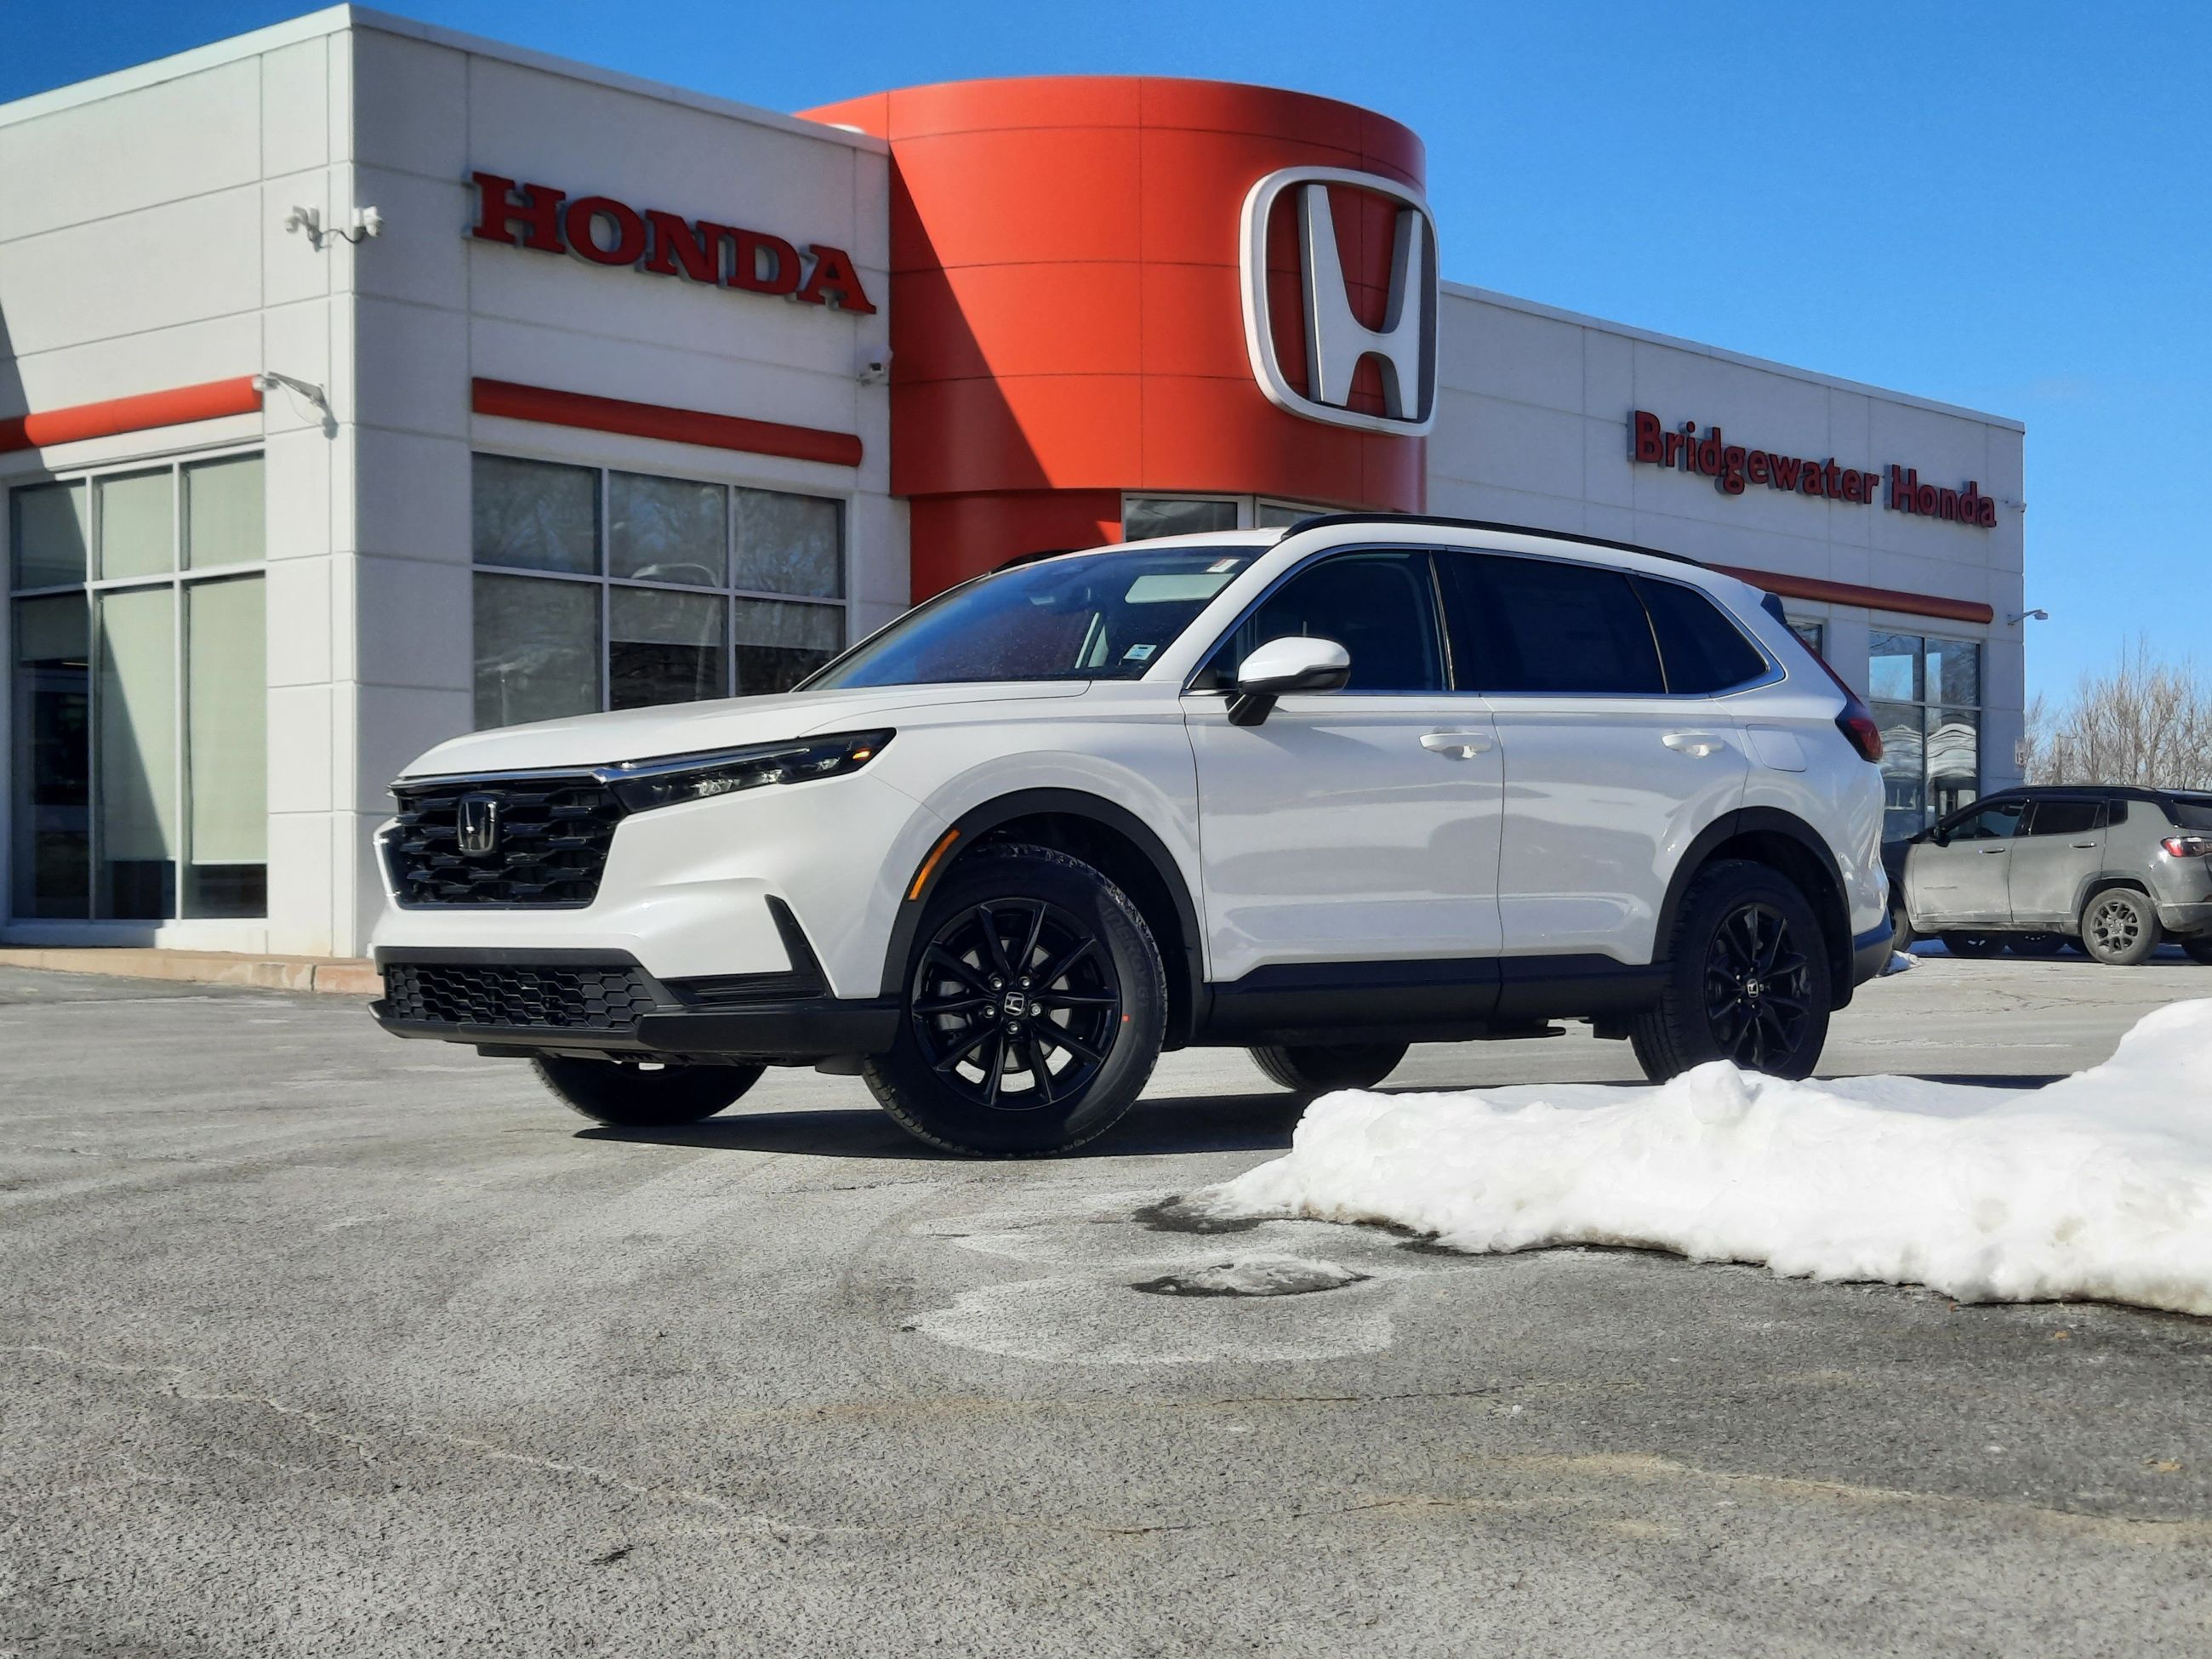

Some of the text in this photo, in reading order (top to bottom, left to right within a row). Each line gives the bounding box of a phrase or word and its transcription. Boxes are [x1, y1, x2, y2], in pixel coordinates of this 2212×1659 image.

[471, 171, 877, 315] HONDA
[1633, 410, 1998, 528] Bridgewater Honda
